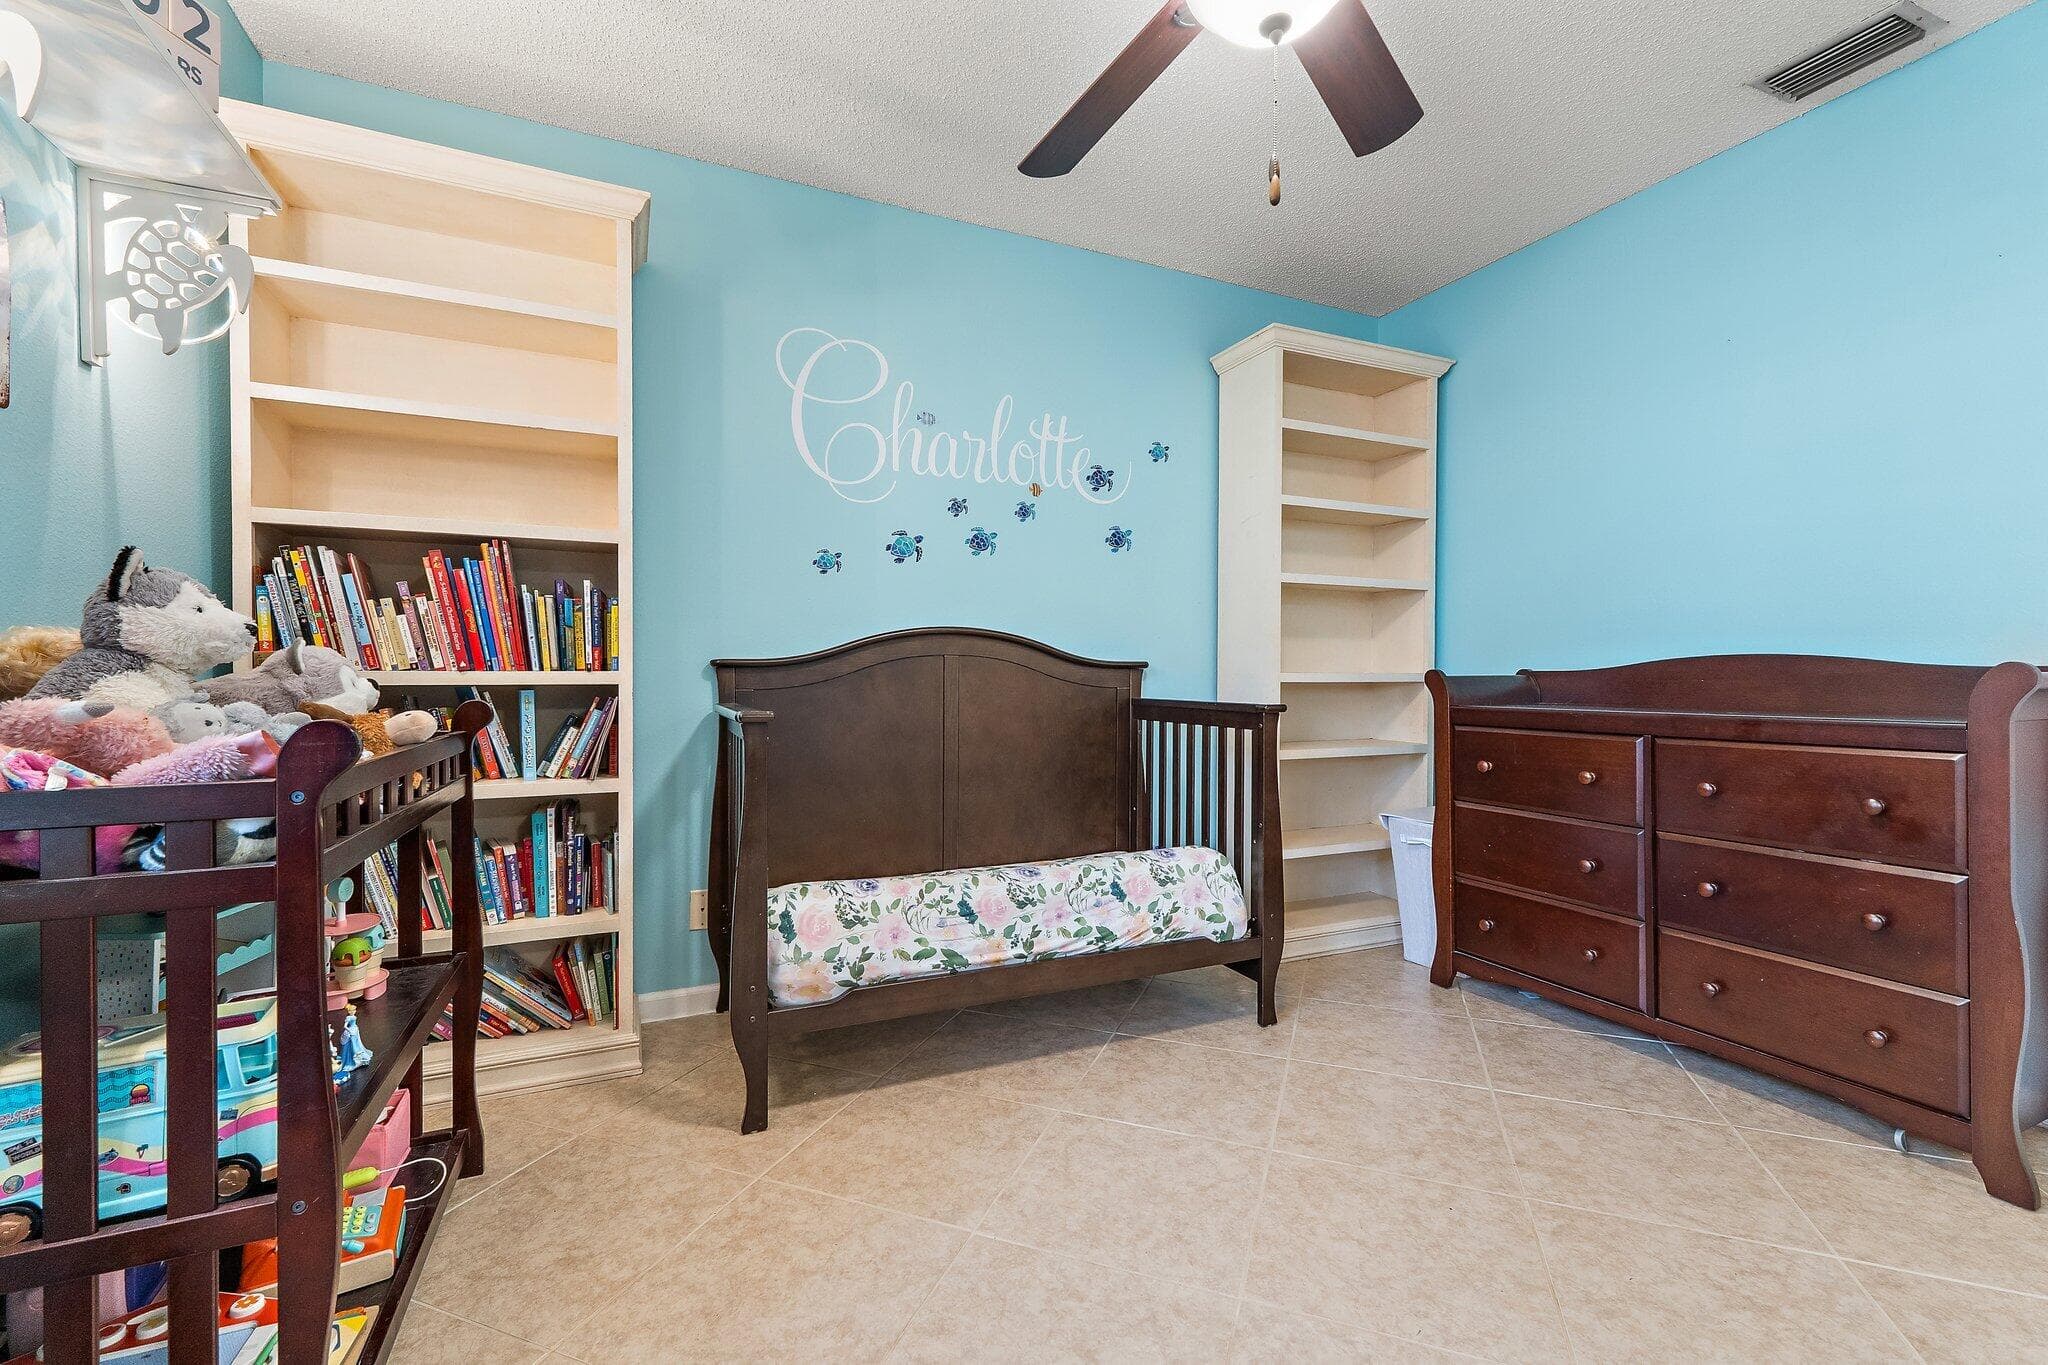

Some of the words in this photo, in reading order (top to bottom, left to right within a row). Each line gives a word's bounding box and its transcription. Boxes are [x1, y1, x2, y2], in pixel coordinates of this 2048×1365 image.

[775, 327, 1132, 504] Charlotte
[266, 578, 279, 602] GENERAL
[439, 580, 451, 606] 5-Minute
[445, 605, 458, 632] Christmas
[451, 631, 462, 650] Stories
